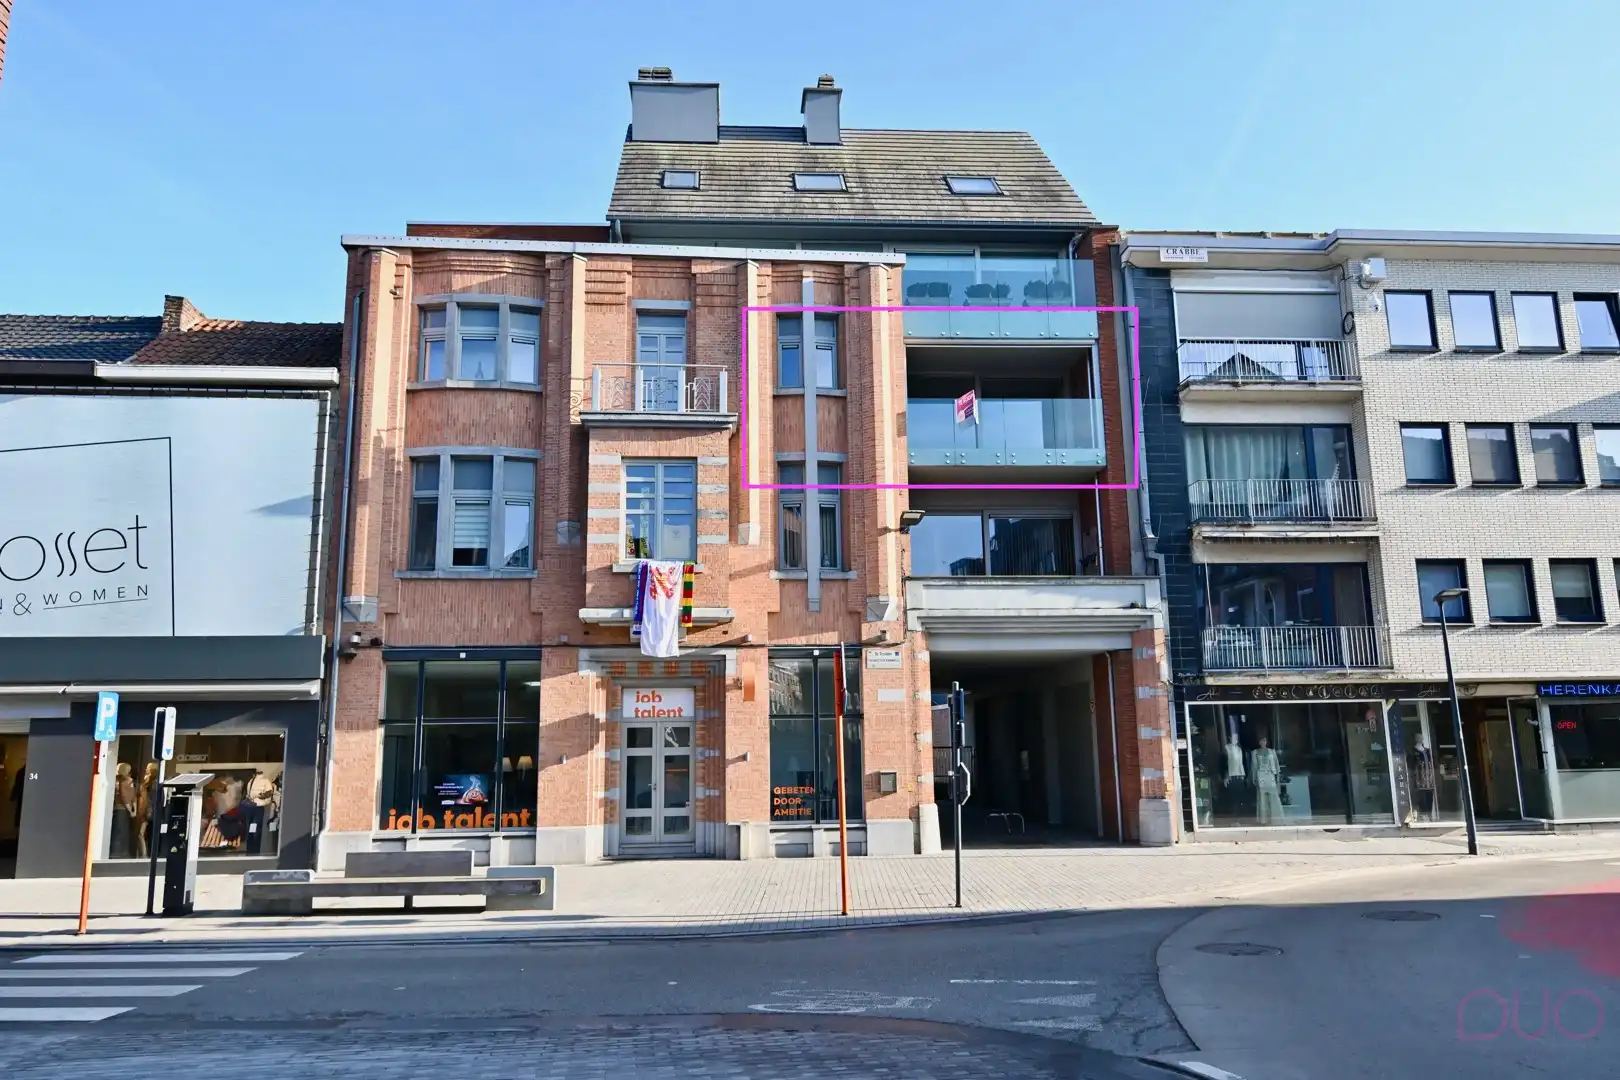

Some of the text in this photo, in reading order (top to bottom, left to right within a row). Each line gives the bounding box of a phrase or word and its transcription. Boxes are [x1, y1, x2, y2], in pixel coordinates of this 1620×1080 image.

[0, 514, 148, 581] osset
[13, 593, 32, 616] &
[43, 584, 148, 606] WOMEN
[635, 690, 663, 703] job
[99, 697, 116, 731] P
[633, 705, 684, 719] talent
[1557, 721, 1577, 729] OPEN
[29, 772, 38, 780] 34
[773, 797, 802, 805] DOOR
[385, 807, 531, 830] job talent
[773, 808, 812, 816] AMBITIE
